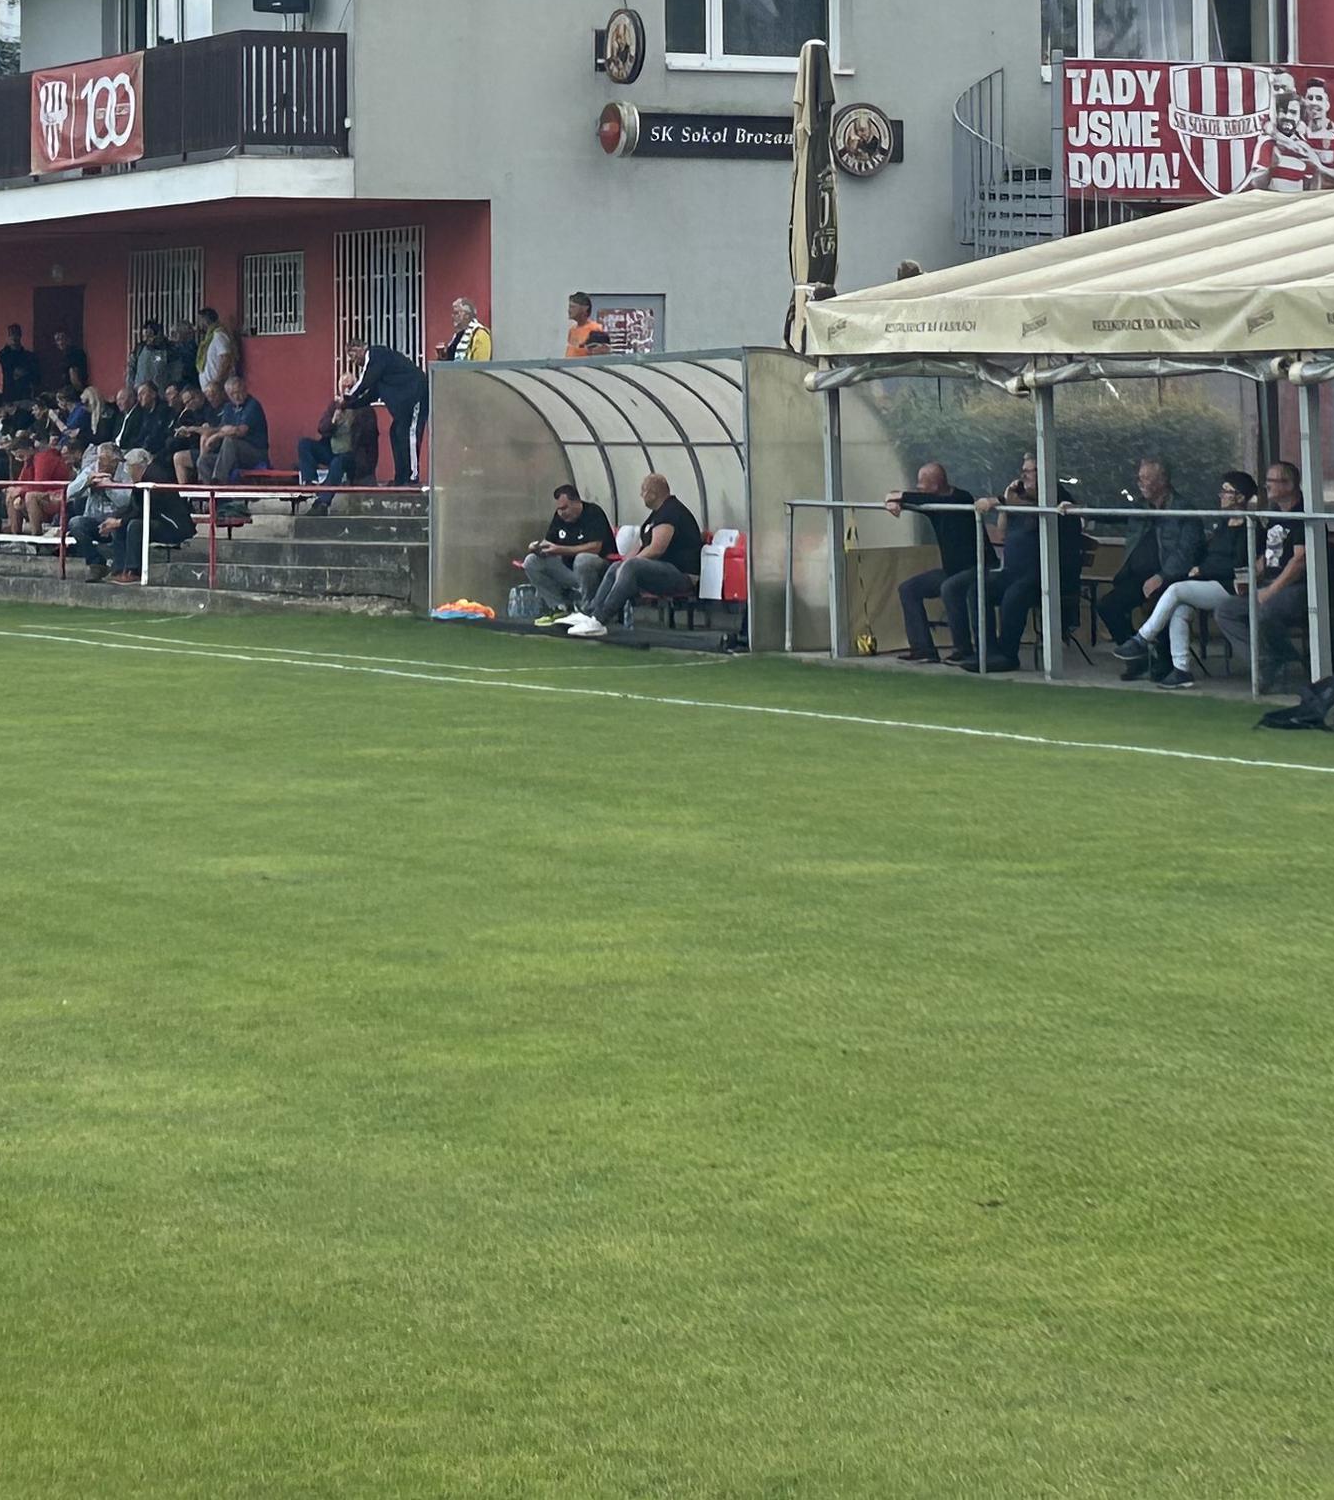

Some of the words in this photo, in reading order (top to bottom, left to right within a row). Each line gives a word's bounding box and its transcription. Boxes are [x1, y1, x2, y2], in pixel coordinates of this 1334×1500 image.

[1066, 68, 1161, 105] TADY
[80, 71, 136, 153] 100
[1068, 110, 1160, 147] JSME
[650, 126, 674, 142] SK
[681, 127, 728, 143] Sokol
[1068, 152, 1180, 189] DOMA!
